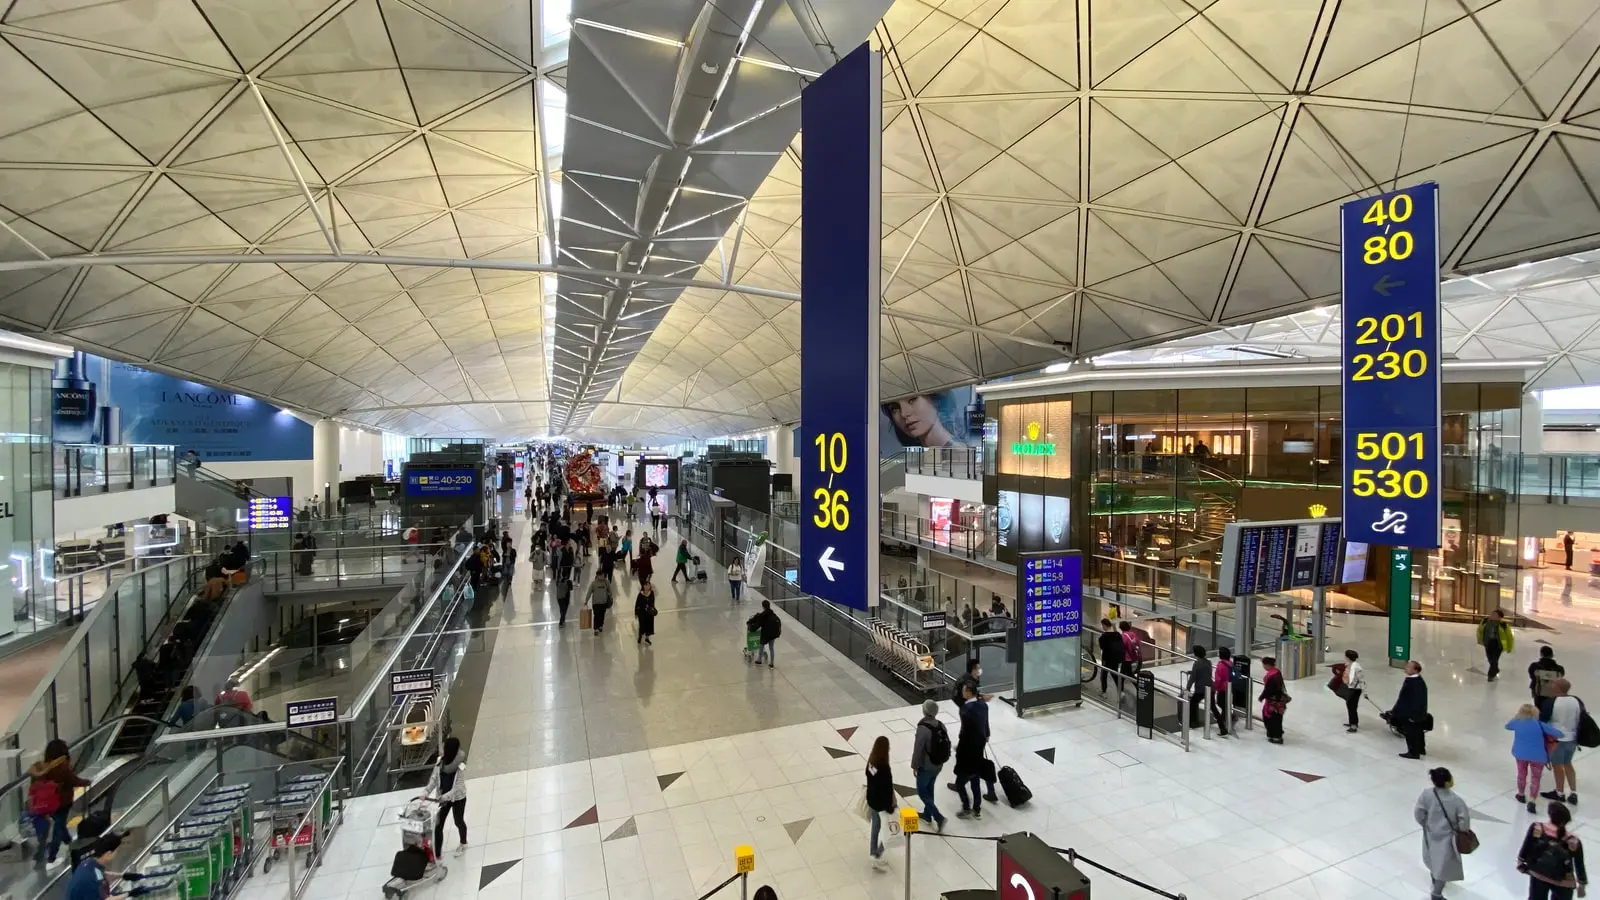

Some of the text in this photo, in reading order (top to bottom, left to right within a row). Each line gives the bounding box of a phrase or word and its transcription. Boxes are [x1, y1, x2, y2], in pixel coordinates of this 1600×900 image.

[1362, 193, 1413, 226] 40
[1363, 230, 1414, 265] 80
[1355, 311, 1423, 345] 201
[1351, 349, 1427, 381] 230
[161, 390, 242, 406] LANCÔME
[815, 432, 848, 474] 10
[1012, 443, 1056, 456] ROLEX
[1356, 432, 1424, 461] 501
[441, 475, 473, 484] 40-230
[1352, 469, 1429, 499] 530
[813, 488, 850, 531] 36
[1053, 560, 1063, 568] 1-4
[1052, 572, 1064, 581] 5-9
[1052, 585, 1071, 594] 10-36
[1052, 599, 1072, 608] 40-80
[1052, 611, 1079, 622] 201-230
[1052, 624, 1079, 635] 501-530
